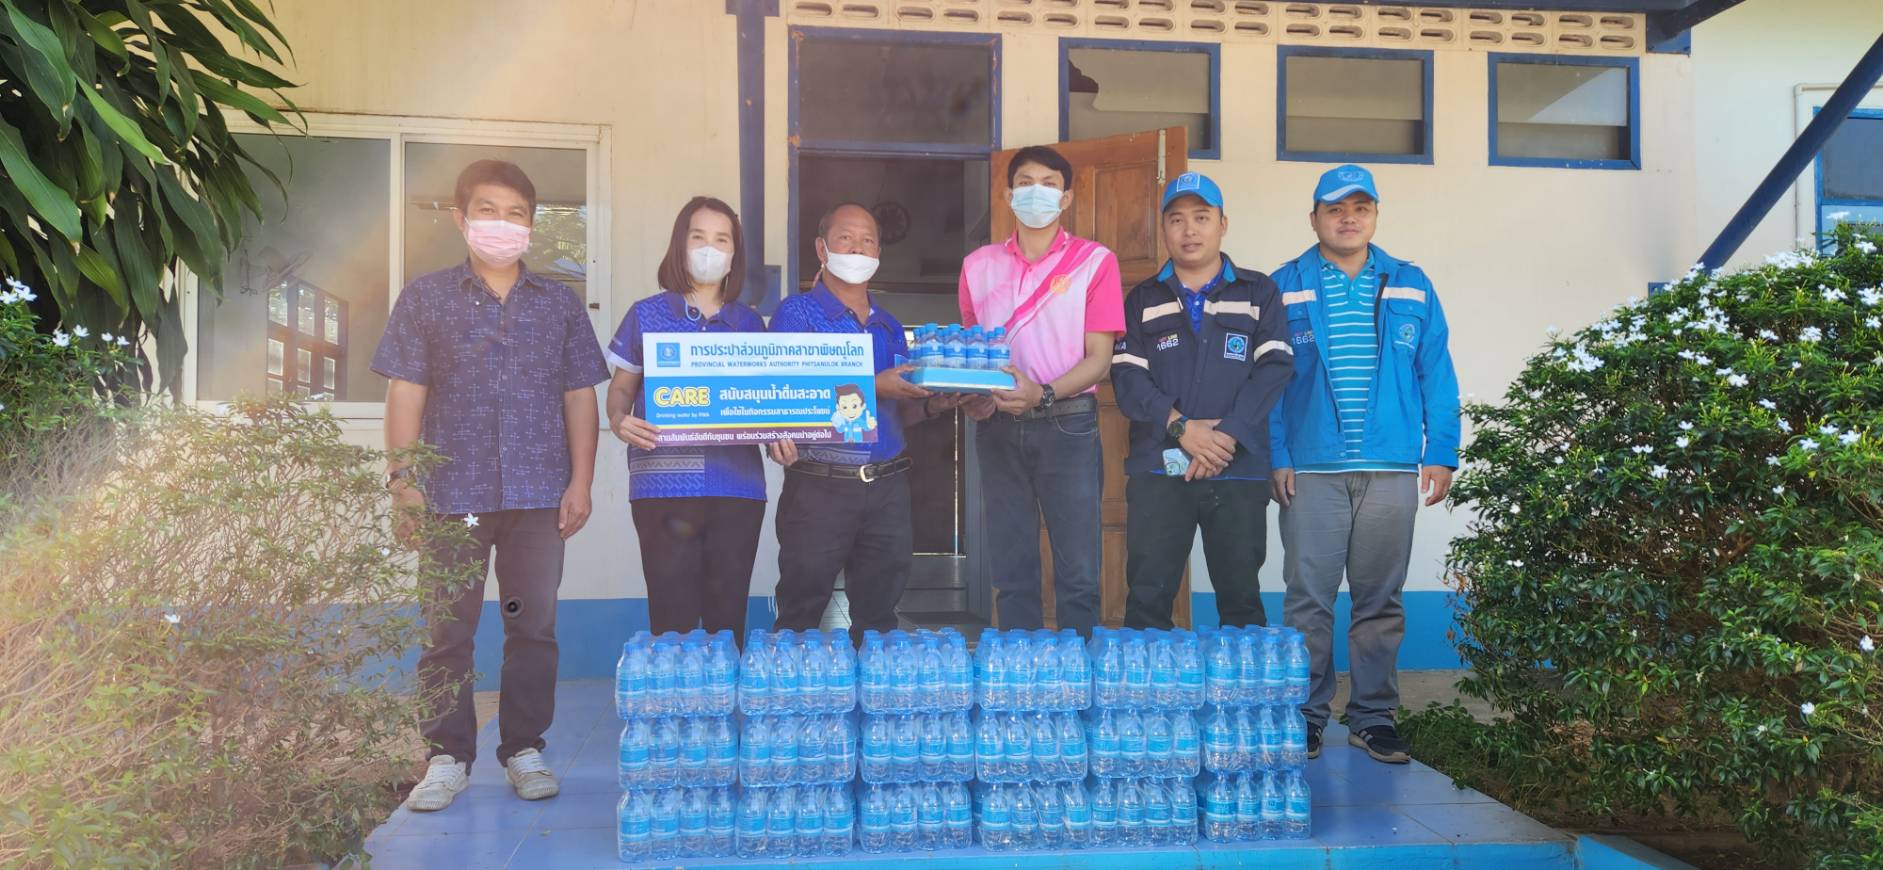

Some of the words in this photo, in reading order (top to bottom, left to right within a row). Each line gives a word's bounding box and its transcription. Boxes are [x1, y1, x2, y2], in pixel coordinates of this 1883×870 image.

[691, 341, 864, 359] การประปาส่วนภูมิภาคสาขาพิษณุโลก
[1156, 338, 1179, 352] 1662
[655, 387, 710, 407] CARE
[720, 384, 830, 403] สนับสนุนน้ำดื่มสะอาด
